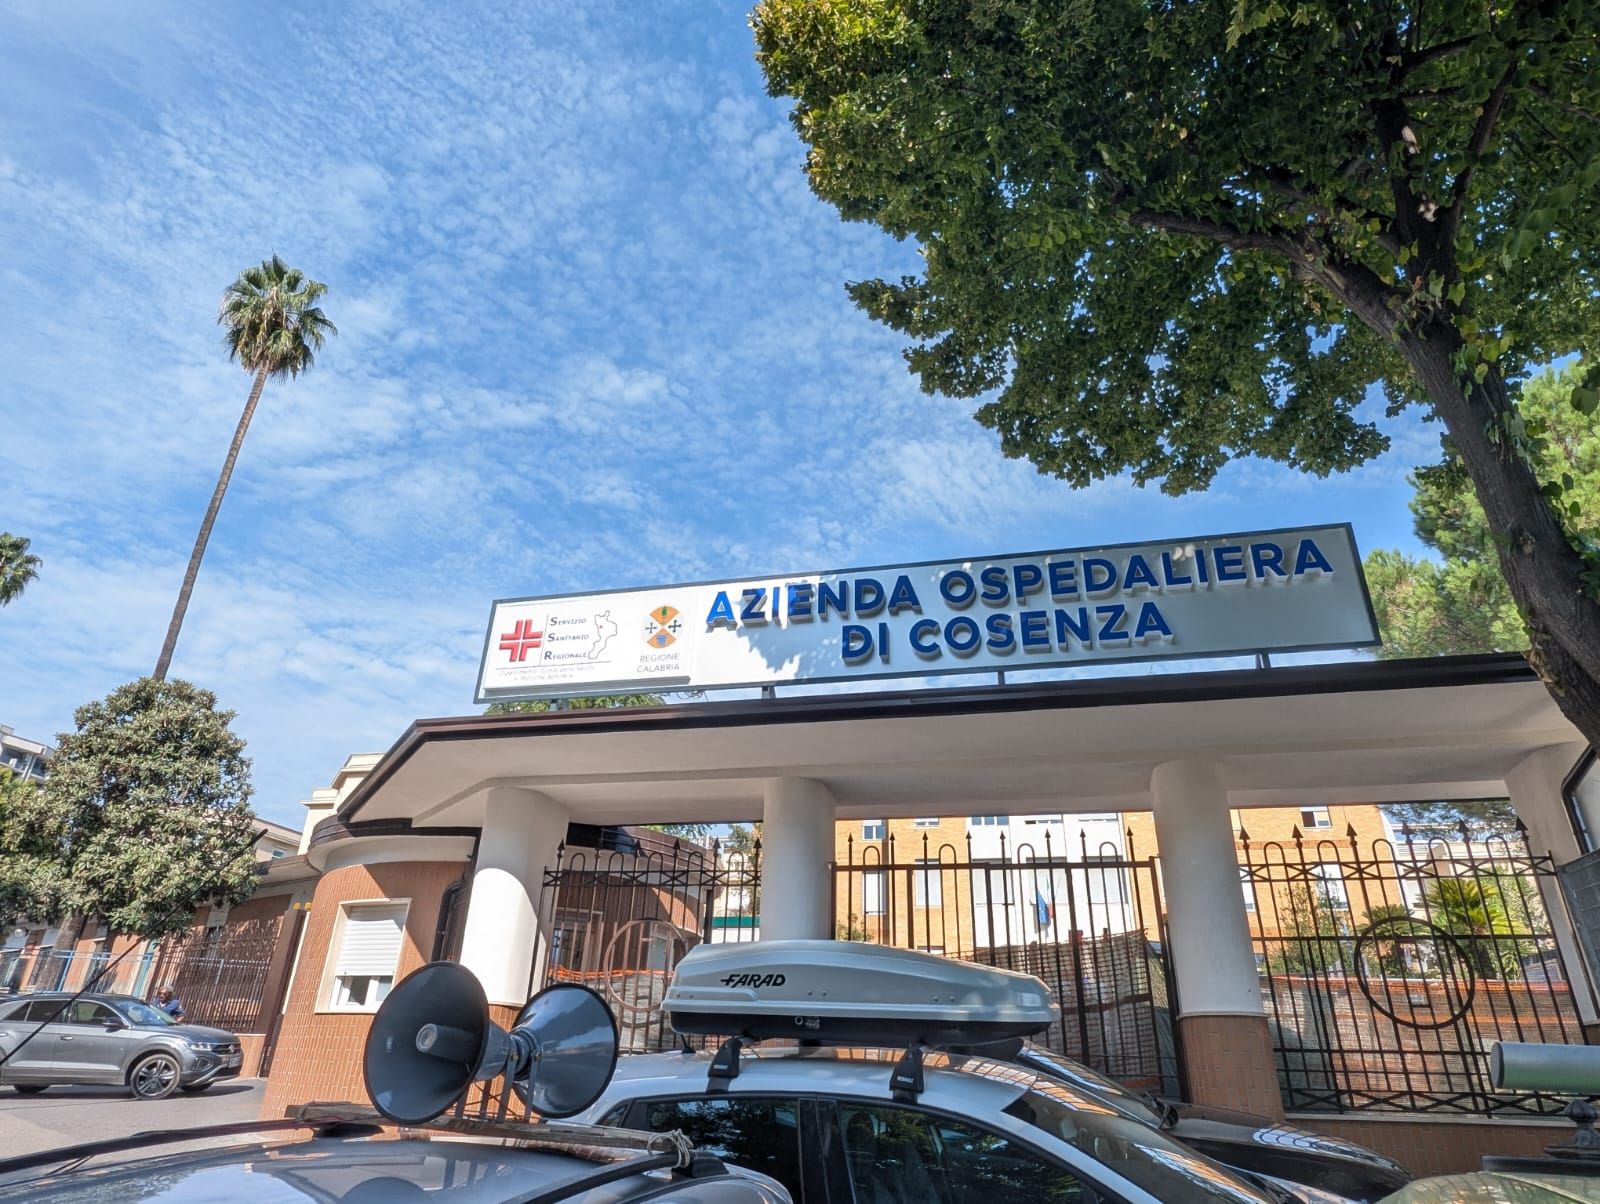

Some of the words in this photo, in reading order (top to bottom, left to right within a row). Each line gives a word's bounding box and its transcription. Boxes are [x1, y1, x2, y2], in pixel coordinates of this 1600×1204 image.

[706, 575, 921, 629] AZIENDA
[939, 538, 1334, 607] OSPEDALIERA
[842, 622, 889, 662] DI
[909, 601, 1174, 658] COSENZA
[639, 652, 680, 663] REGIONE
[636, 663, 680, 673] CALABRIA
[721, 973, 785, 988] FARAD
